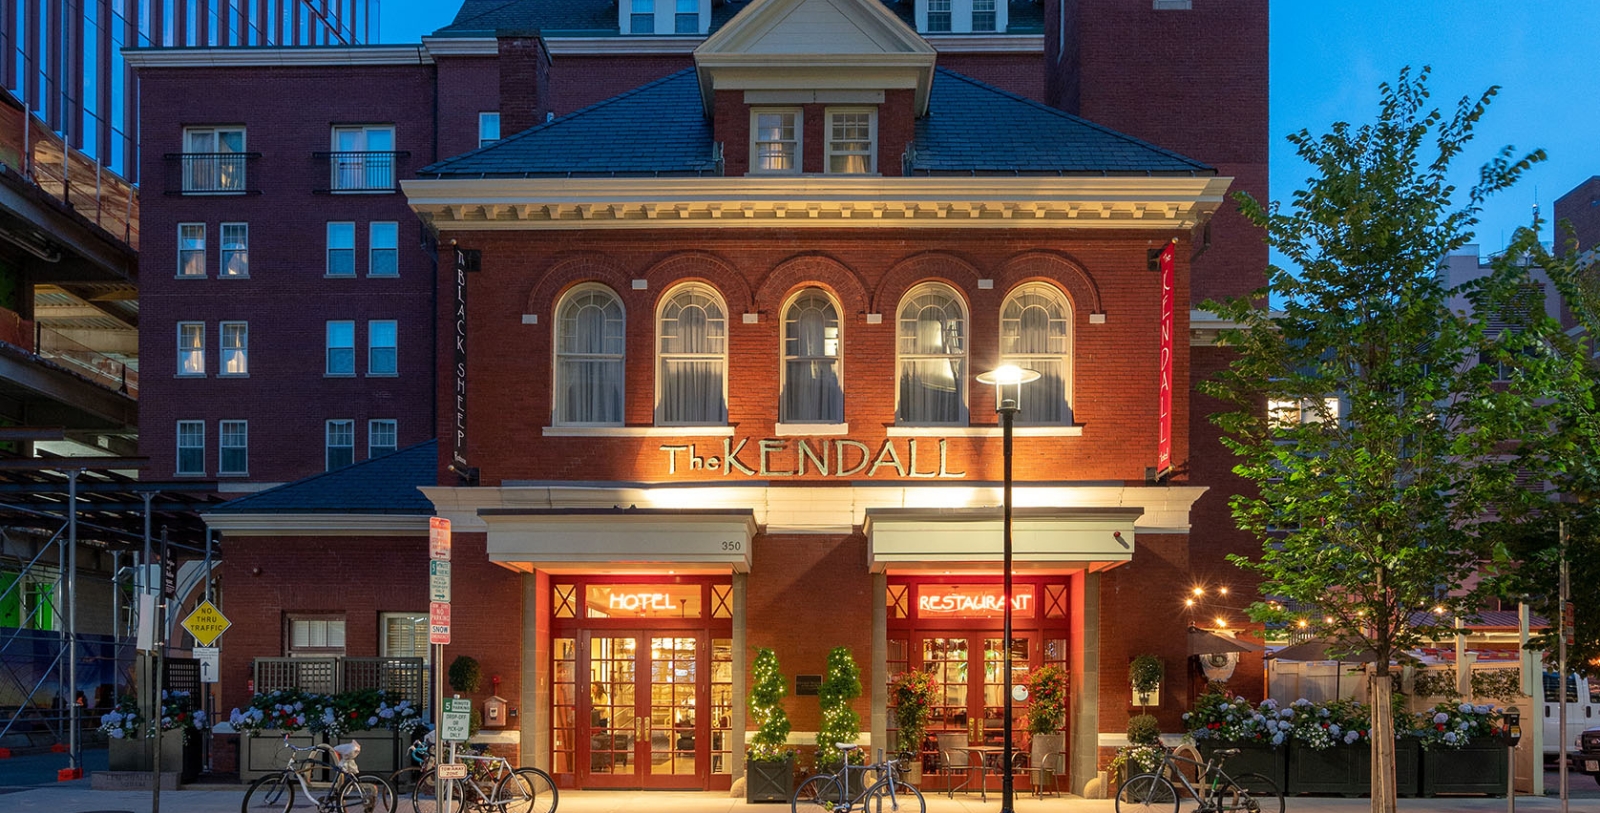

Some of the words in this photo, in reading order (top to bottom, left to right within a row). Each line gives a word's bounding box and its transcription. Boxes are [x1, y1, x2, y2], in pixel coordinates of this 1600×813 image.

[456, 269, 466, 355] BLACK
[456, 362, 466, 447] SHEEP
[659, 444, 721, 475] The
[723, 437, 967, 478] KENDALL
[721, 541, 742, 551] 350
[609, 593, 676, 610] HOTEL
[919, 594, 1032, 611] RESTAURANT
[190, 624, 223, 632] TRAFFIC
[446, 702, 451, 710] 5
